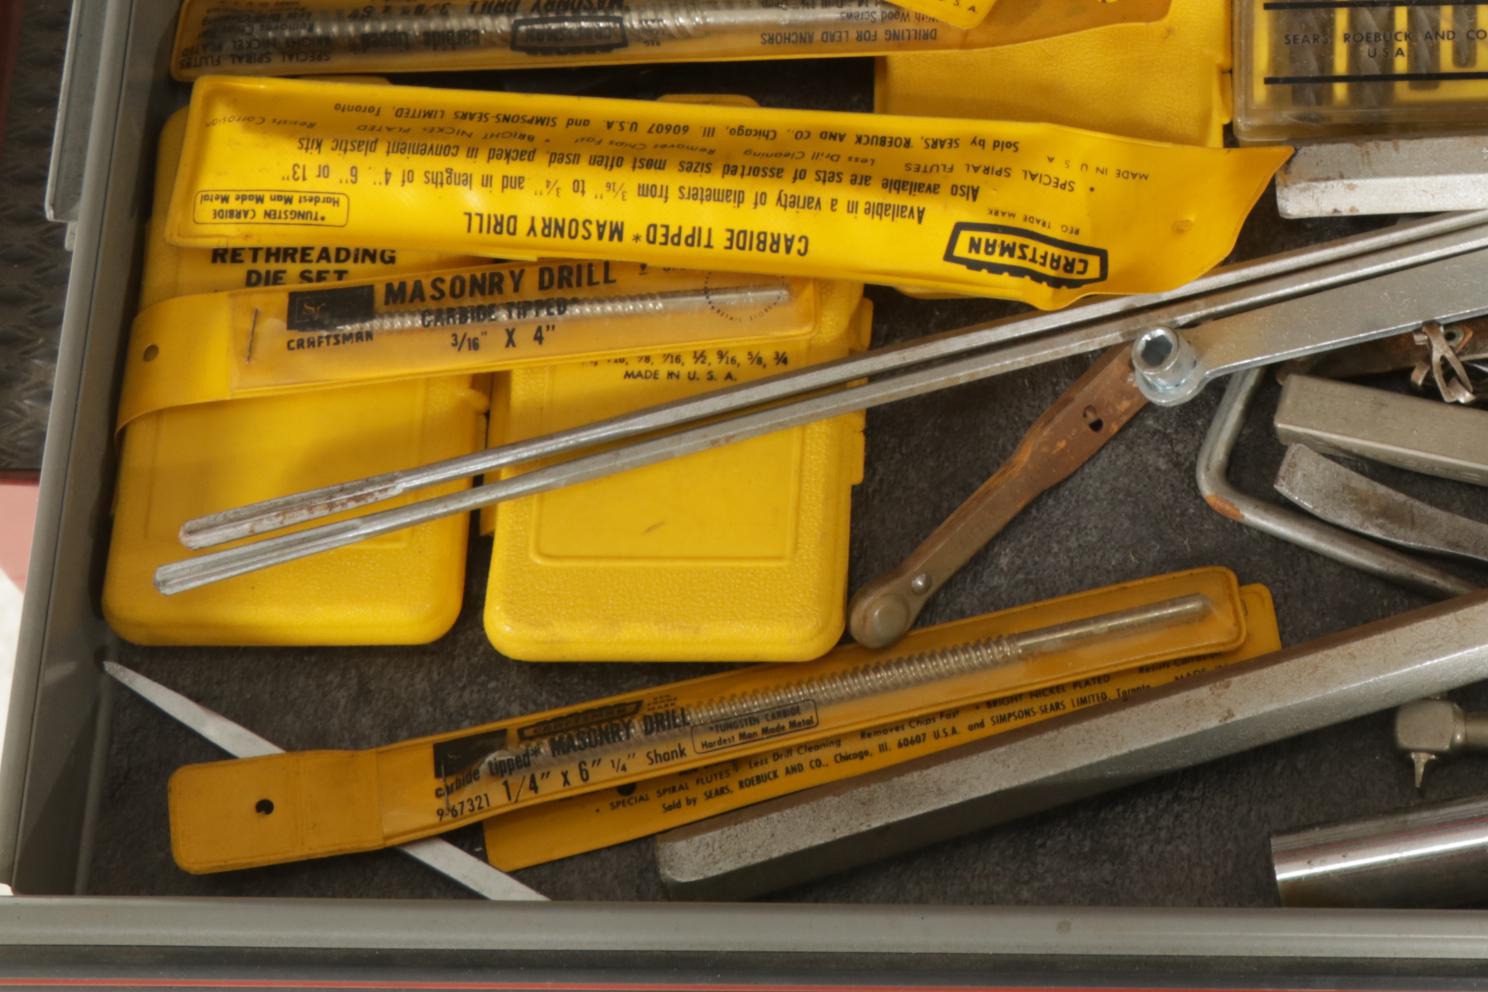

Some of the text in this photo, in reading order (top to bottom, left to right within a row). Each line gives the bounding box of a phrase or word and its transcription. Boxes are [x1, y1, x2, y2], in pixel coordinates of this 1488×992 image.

[838, 9, 910, 24] Wood Screws
[758, 27, 938, 45] DRILLING FOR LEAD ANCHORS
[1343, 31, 1412, 42] ROEBUCK
[1423, 30, 1456, 40] AND
[281, 48, 330, 63] SPECIAL
[333, 102, 1020, 152] Sold by ROEBUCK AND Chicago, 60607 and SIMPSONS-SEARS Toronto
[330, 136, 979, 201] Also available are sets of assorted sizes most often packed in convenient plastic
[903, 160, 1076, 191] SPECIAL SPIRAL FLUTES
[1095, 165, 1149, 181] MADE IN
[200, 192, 339, 208] Hardest Man Made Metal
[316, 163, 925, 224] Available in variety of diameters from to and in lengths of or
[211, 207, 255, 220] CARBIDE
[1022, 213, 1052, 228] TRADE
[462, 211, 810, 256] CARBIDE MASONRY DRILL
[210, 244, 396, 266] RETHREADING
[966, 236, 1090, 276] CRAFTSMAN
[245, 269, 286, 287] DIE
[381, 259, 617, 305] MASONRY DRILL
[419, 303, 496, 328] CARBIDE
[286, 329, 375, 350] CRAFTSMAN
[624, 369, 679, 380] MADE IN
[431, 719, 634, 798] carbide MASONRY
[435, 742, 687, 820] 9-67321 Shank
[661, 732, 927, 813] Sold ROEBUCK AND 60607
[609, 793, 650, 809] SPECIAL
